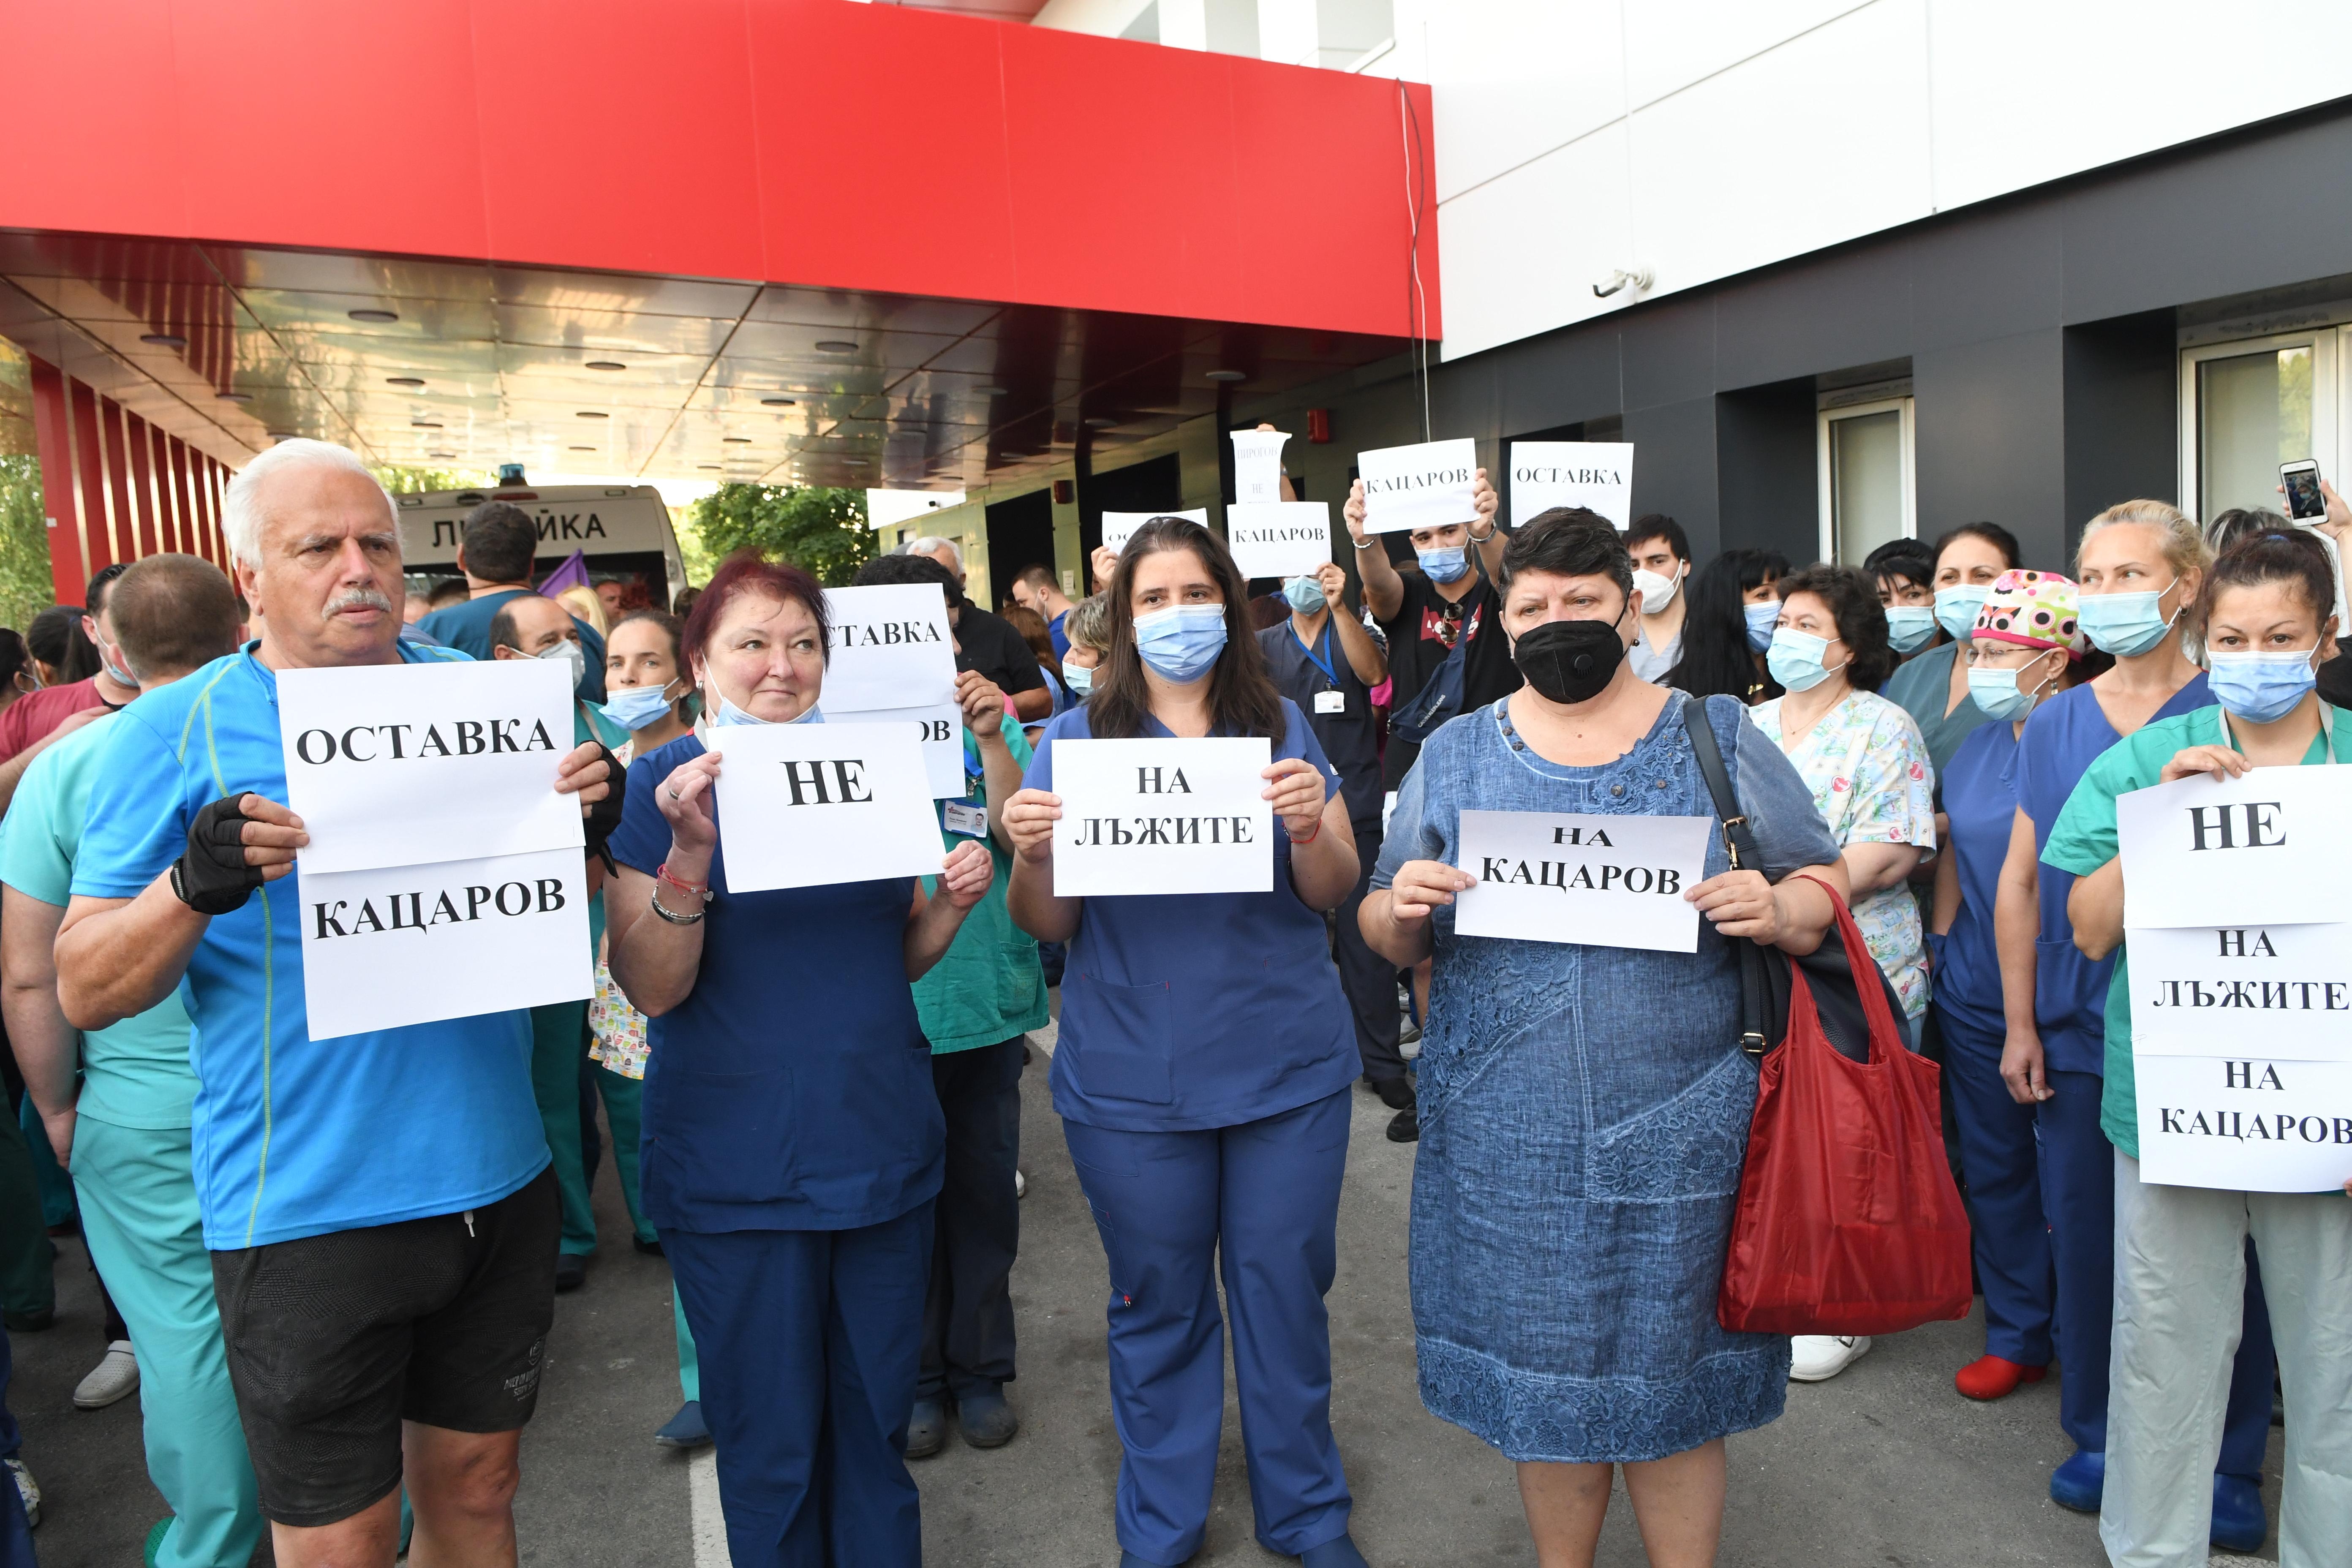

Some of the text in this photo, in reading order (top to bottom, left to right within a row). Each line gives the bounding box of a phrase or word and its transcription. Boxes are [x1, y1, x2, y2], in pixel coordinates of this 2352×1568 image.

[1237, 446, 1277, 460] ПИРОГОВ
[1252, 483, 1263, 494] НЕ
[1367, 468, 1468, 494] КАЦАРОВ
[1516, 468, 1621, 485] ОСТАВКА
[433, 509, 607, 547] ЛЙКА
[1236, 528, 1324, 544] КАЦАРОВ
[828, 621, 942, 648] ТАВКА
[297, 718, 557, 765] ОСТАВКА
[779, 759, 873, 806] НЕ
[1136, 767, 1193, 794] НА
[1075, 817, 1253, 846] ЛЪЖИТЕ
[1550, 827, 1615, 847] НА
[2185, 801, 2286, 851] НЕ
[1479, 857, 1680, 894] КАЦАРОВ
[311, 878, 566, 940] КАЦАРОВ
[2216, 929, 2279, 957] НА
[2153, 980, 2349, 1010] ЛЪЖИТЕ
[2223, 1061, 2285, 1091] НА
[2158, 1108, 2352, 1144] КАЦАРОВ
